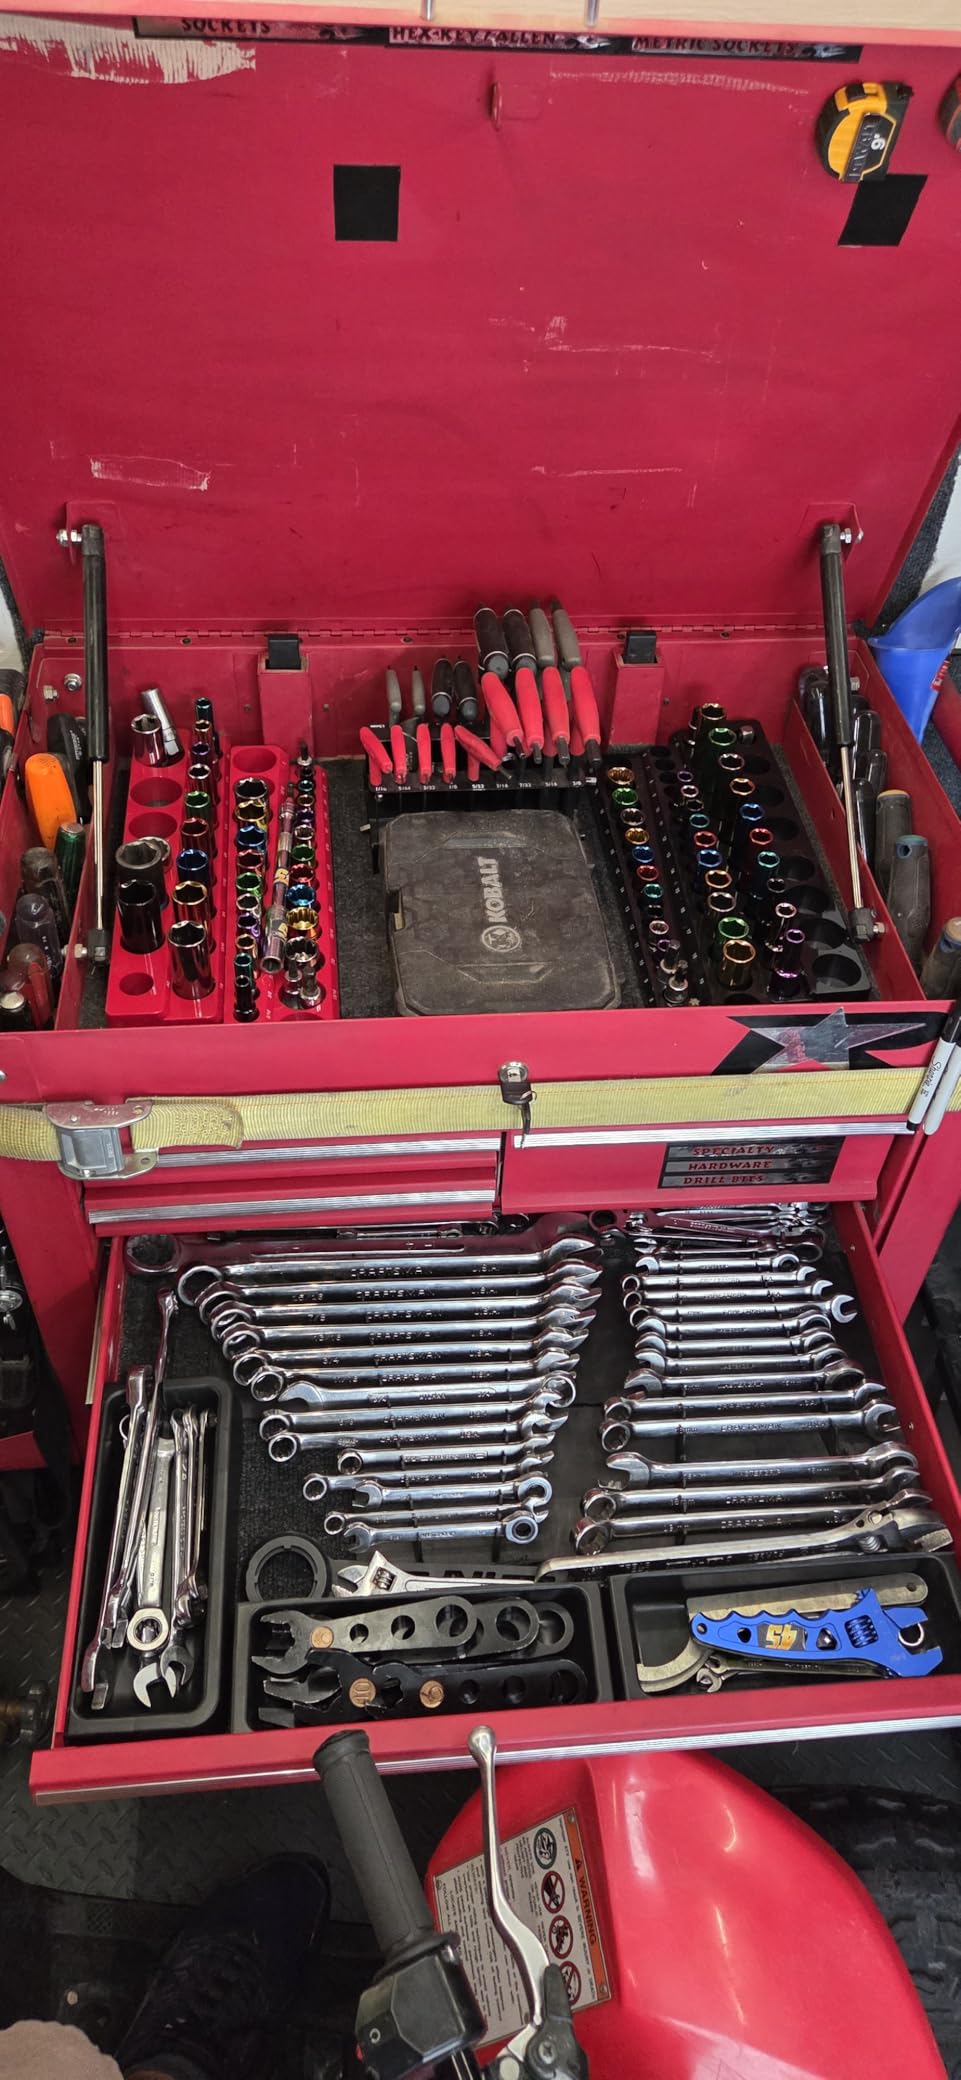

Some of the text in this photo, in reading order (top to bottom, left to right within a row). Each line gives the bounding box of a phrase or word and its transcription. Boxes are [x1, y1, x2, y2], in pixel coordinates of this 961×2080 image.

[181, 17, 271, 34] SOCKETS
[634, 36, 796, 54] METRIC SOCKETS
[478, 856, 507, 922] KOBALT
[692, 1144, 776, 1157] SPECIALTY
[688, 1160, 773, 1171] HARDWARE
[683, 1173, 764, 1185] DRILL BITS
[577, 1875, 597, 1945] WARNING
